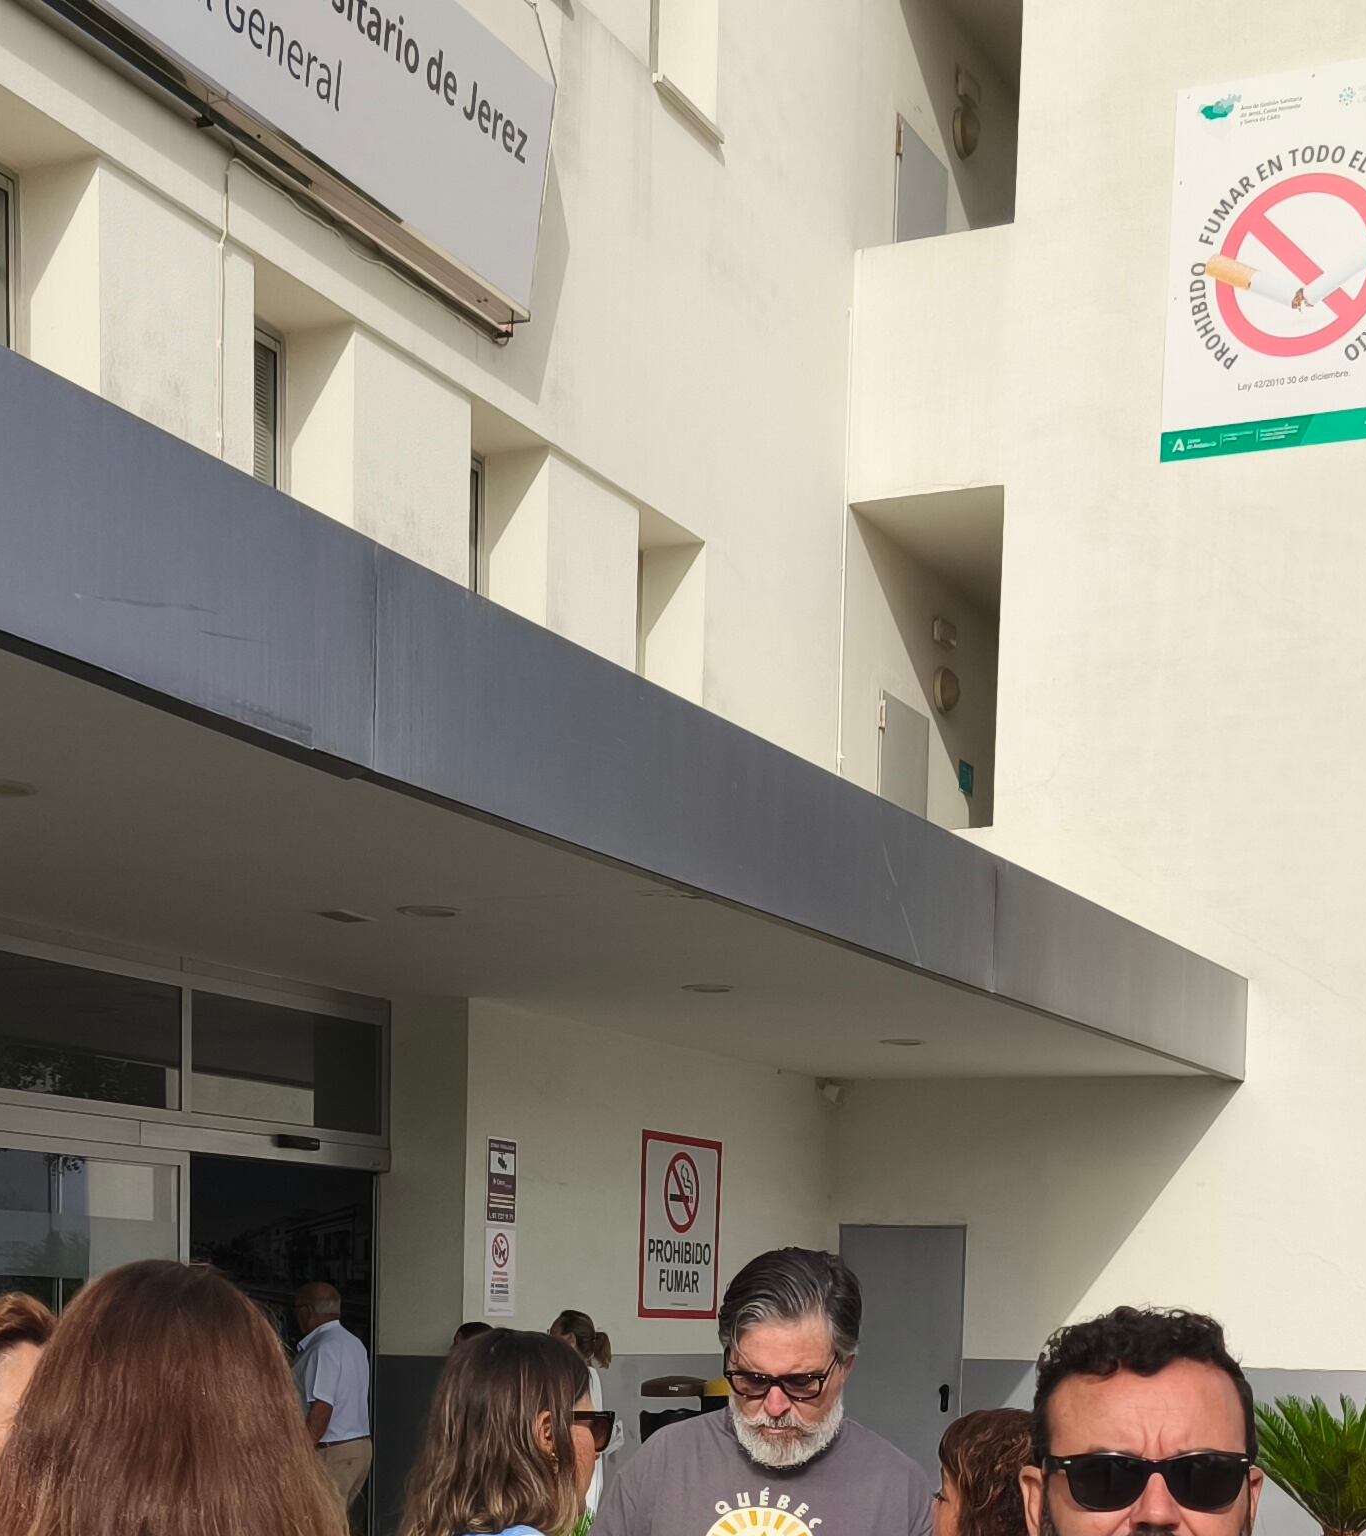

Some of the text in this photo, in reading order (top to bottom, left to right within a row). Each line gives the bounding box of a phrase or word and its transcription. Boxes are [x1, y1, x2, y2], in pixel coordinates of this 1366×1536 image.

[225, 0, 342, 112] General
[426, 49, 457, 106] de
[462, 80, 528, 164] Jerez
[1255, 154, 1284, 182] EN
[1287, 144, 1346, 167] TODO
[1198, 175, 1256, 246] FUMAR
[1189, 262, 1239, 370] PROHIBIDO
[647, 1238, 712, 1266] PROHIBIDO
[658, 1268, 700, 1294] FUMAR
[714, 1486, 823, 1529] QUÉBEC
